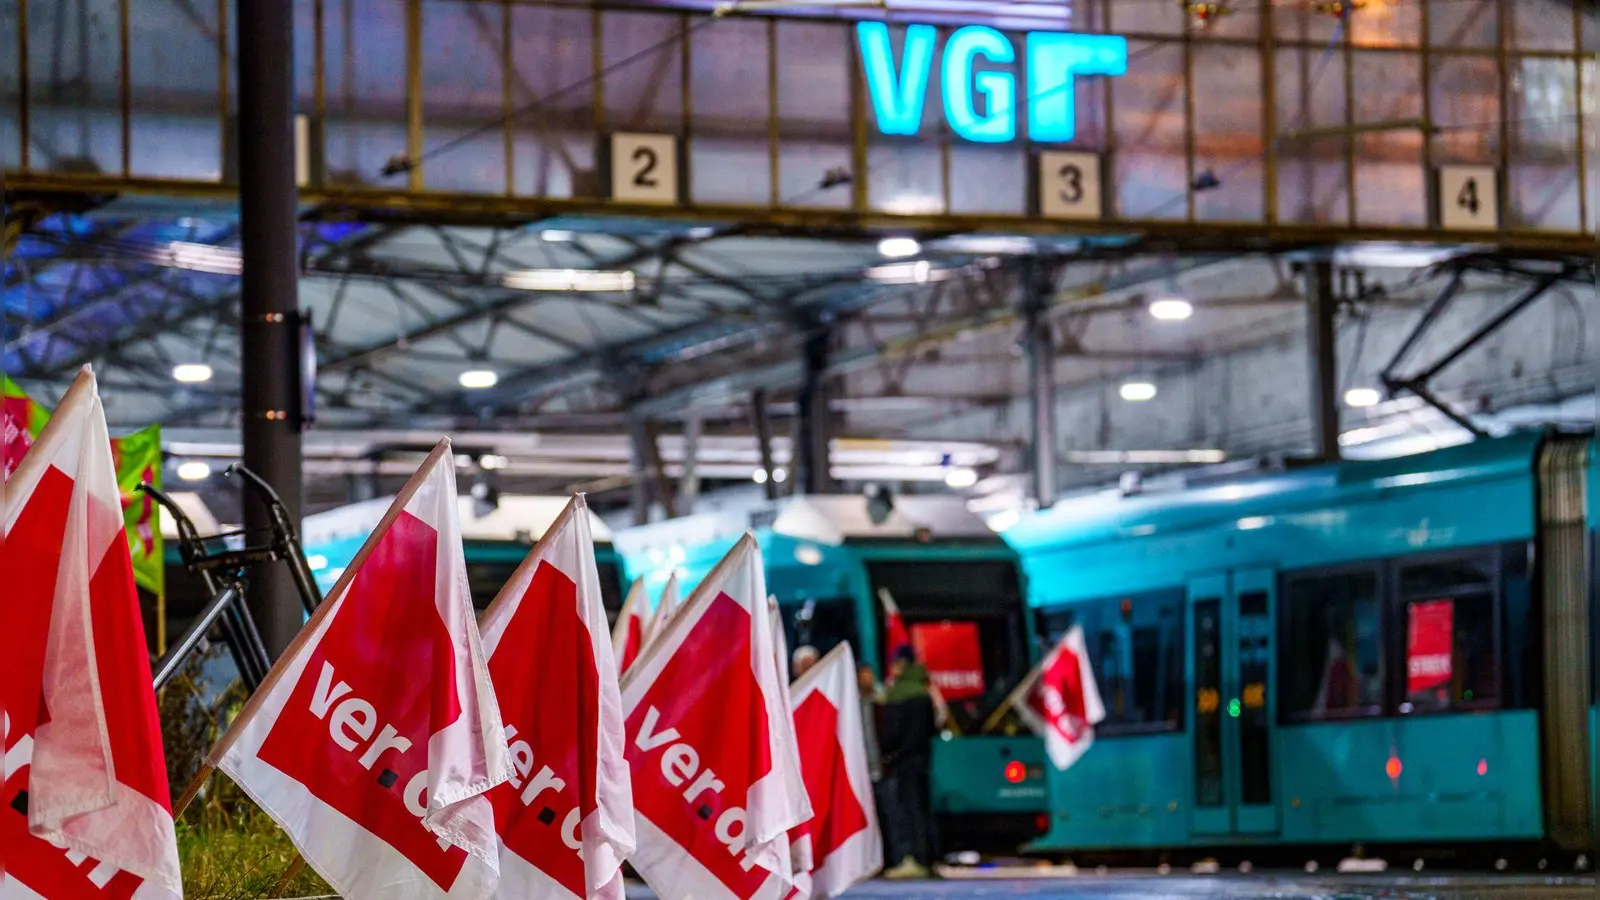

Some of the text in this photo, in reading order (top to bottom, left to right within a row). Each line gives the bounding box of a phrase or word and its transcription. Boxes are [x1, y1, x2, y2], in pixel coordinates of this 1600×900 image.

[632, 147, 657, 187] 2
[1059, 165, 1083, 203] 3
[1457, 177, 1481, 215] 4
[309, 660, 452, 852] ver.
[503, 724, 584, 862] er.
